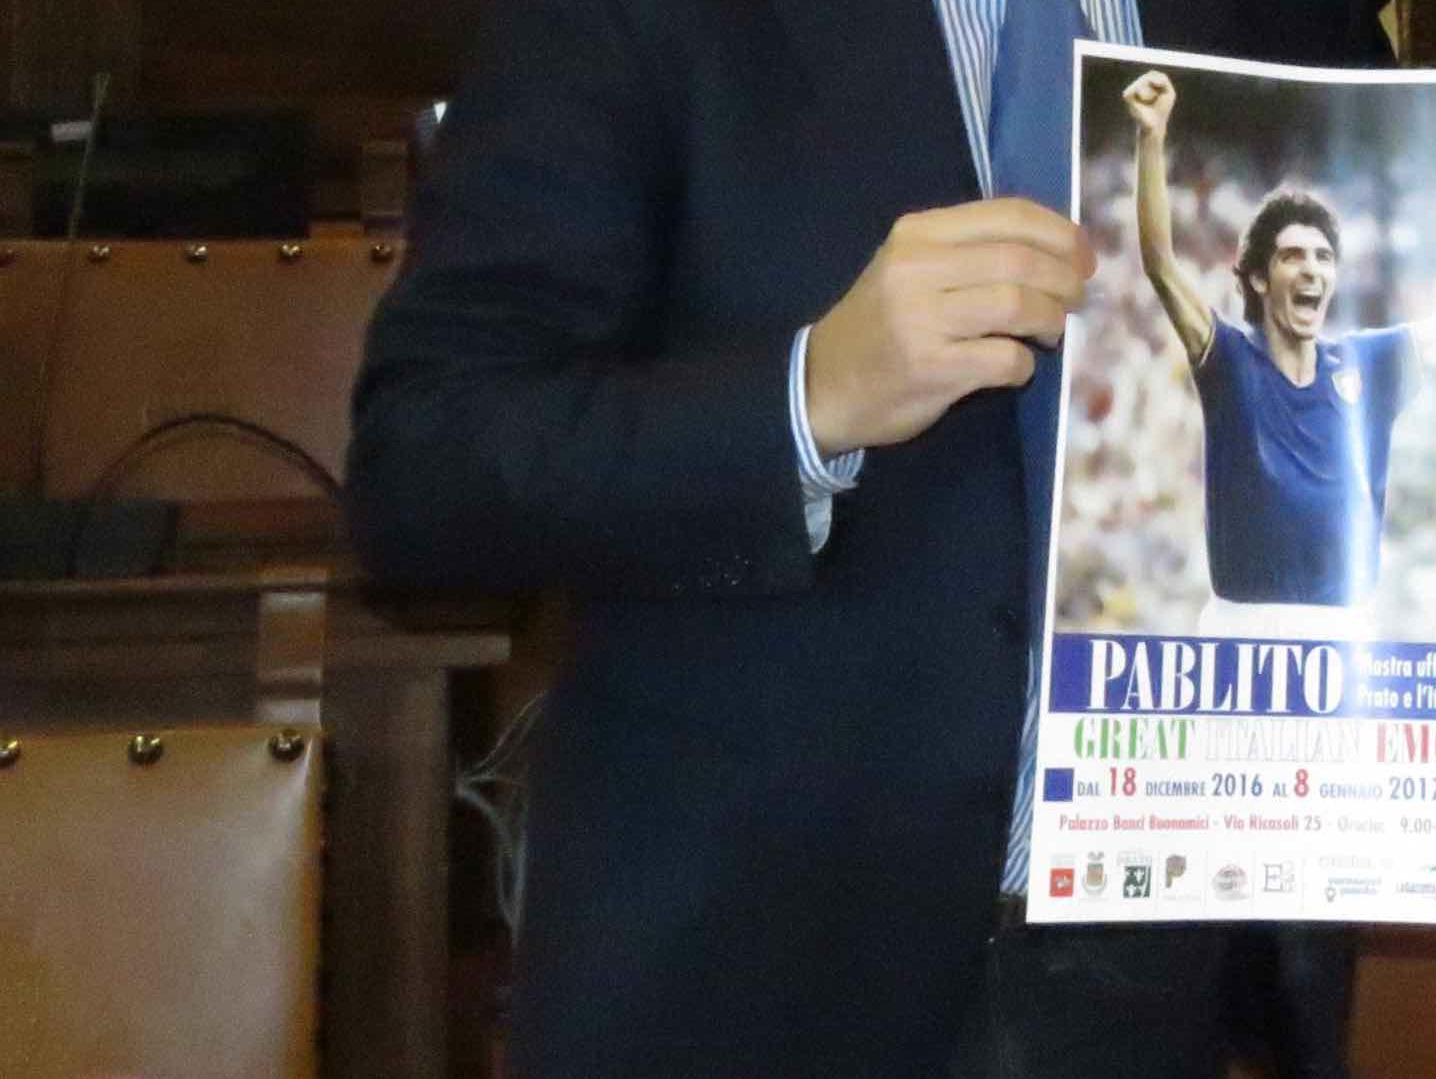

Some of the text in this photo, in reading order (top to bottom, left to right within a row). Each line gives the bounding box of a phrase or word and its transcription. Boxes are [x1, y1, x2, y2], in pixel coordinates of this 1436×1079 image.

[1088, 639, 1344, 714] PABLITO
[1358, 687, 1400, 709] Prato
[1404, 695, 1413, 709] e
[1073, 718, 1195, 760] GREAT
[1203, 720, 1362, 764] ITALIAN
[1077, 782, 1100, 796] DAL
[1108, 767, 1137, 796] 18
[1145, 779, 1206, 797] DICEMBRE
[1211, 772, 1263, 797] 2016
[1272, 782, 1288, 798] AL
[1293, 768, 1310, 797] 8
[1319, 783, 1382, 800] GENNAIO
[1059, 814, 1108, 831] Palazzo
[1223, 814, 1245, 830] Via
[1249, 814, 1300, 831] Ricasoli
[1304, 815, 1322, 831] 25
